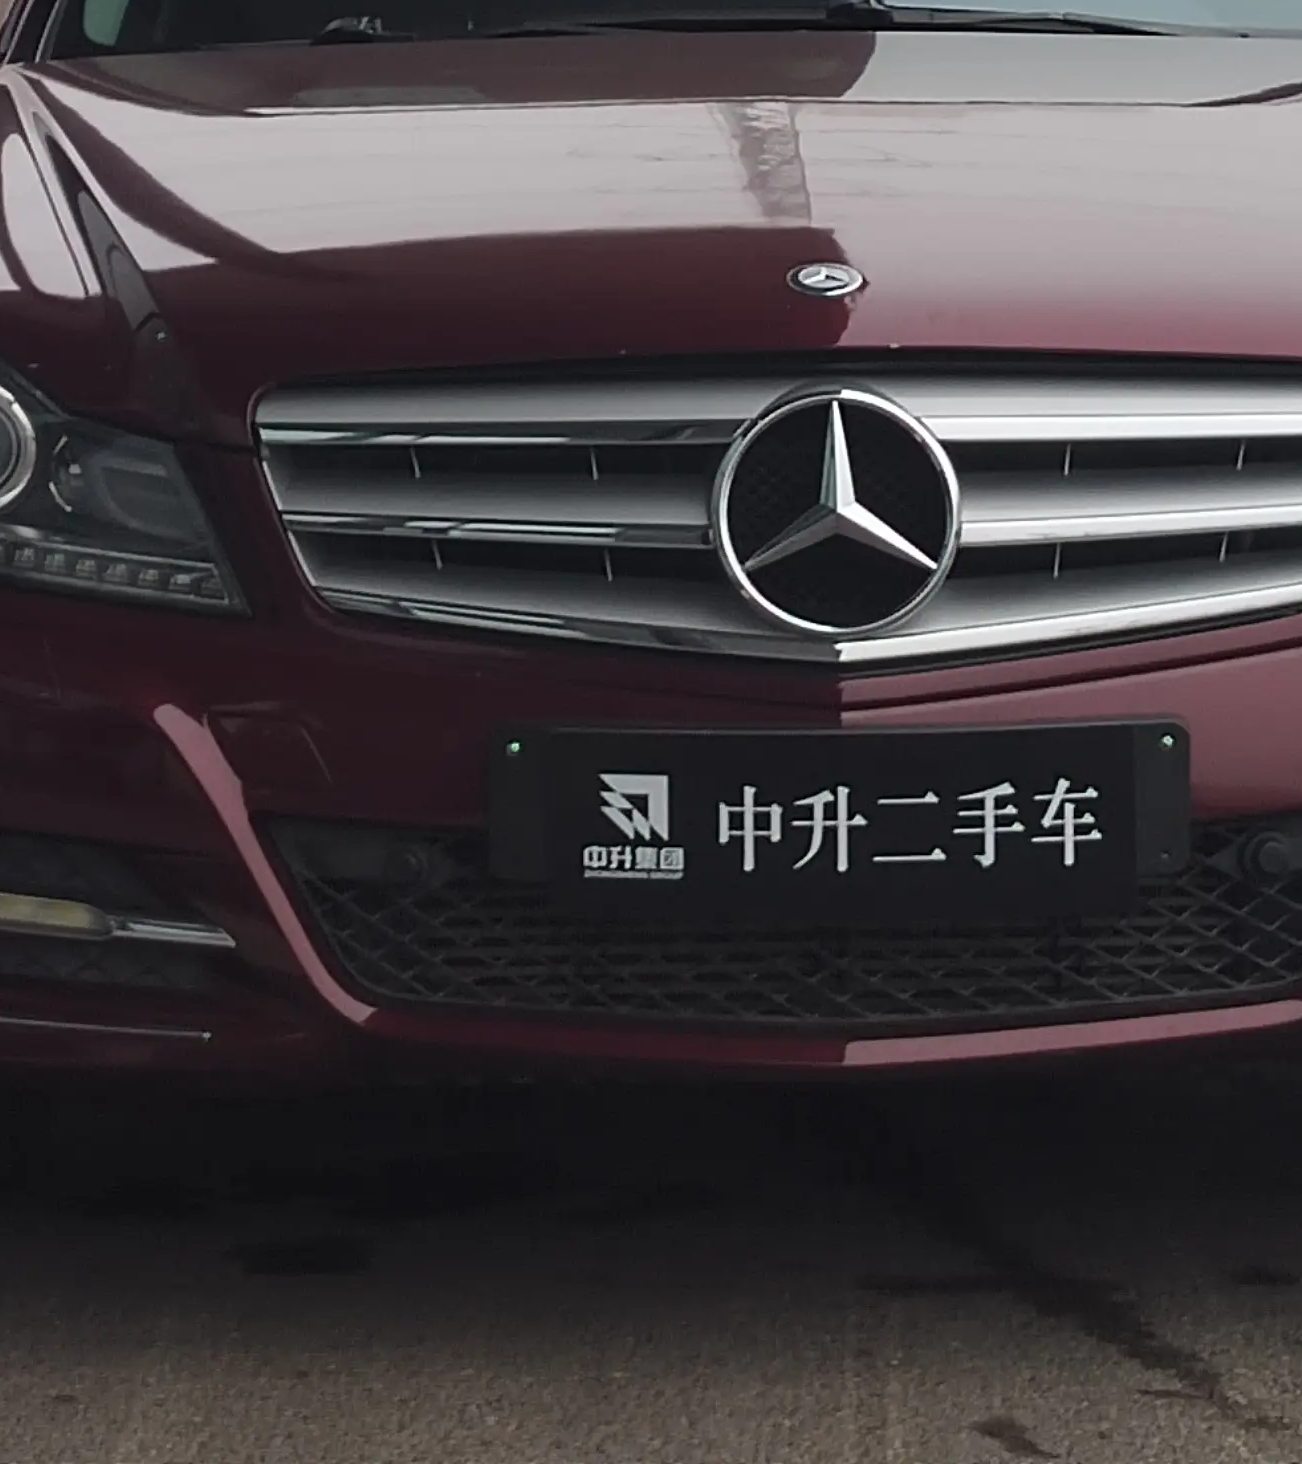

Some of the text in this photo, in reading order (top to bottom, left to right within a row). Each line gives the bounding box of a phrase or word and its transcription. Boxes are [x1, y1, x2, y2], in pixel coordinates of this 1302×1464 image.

[717, 778, 1102, 873] 中升二手车
